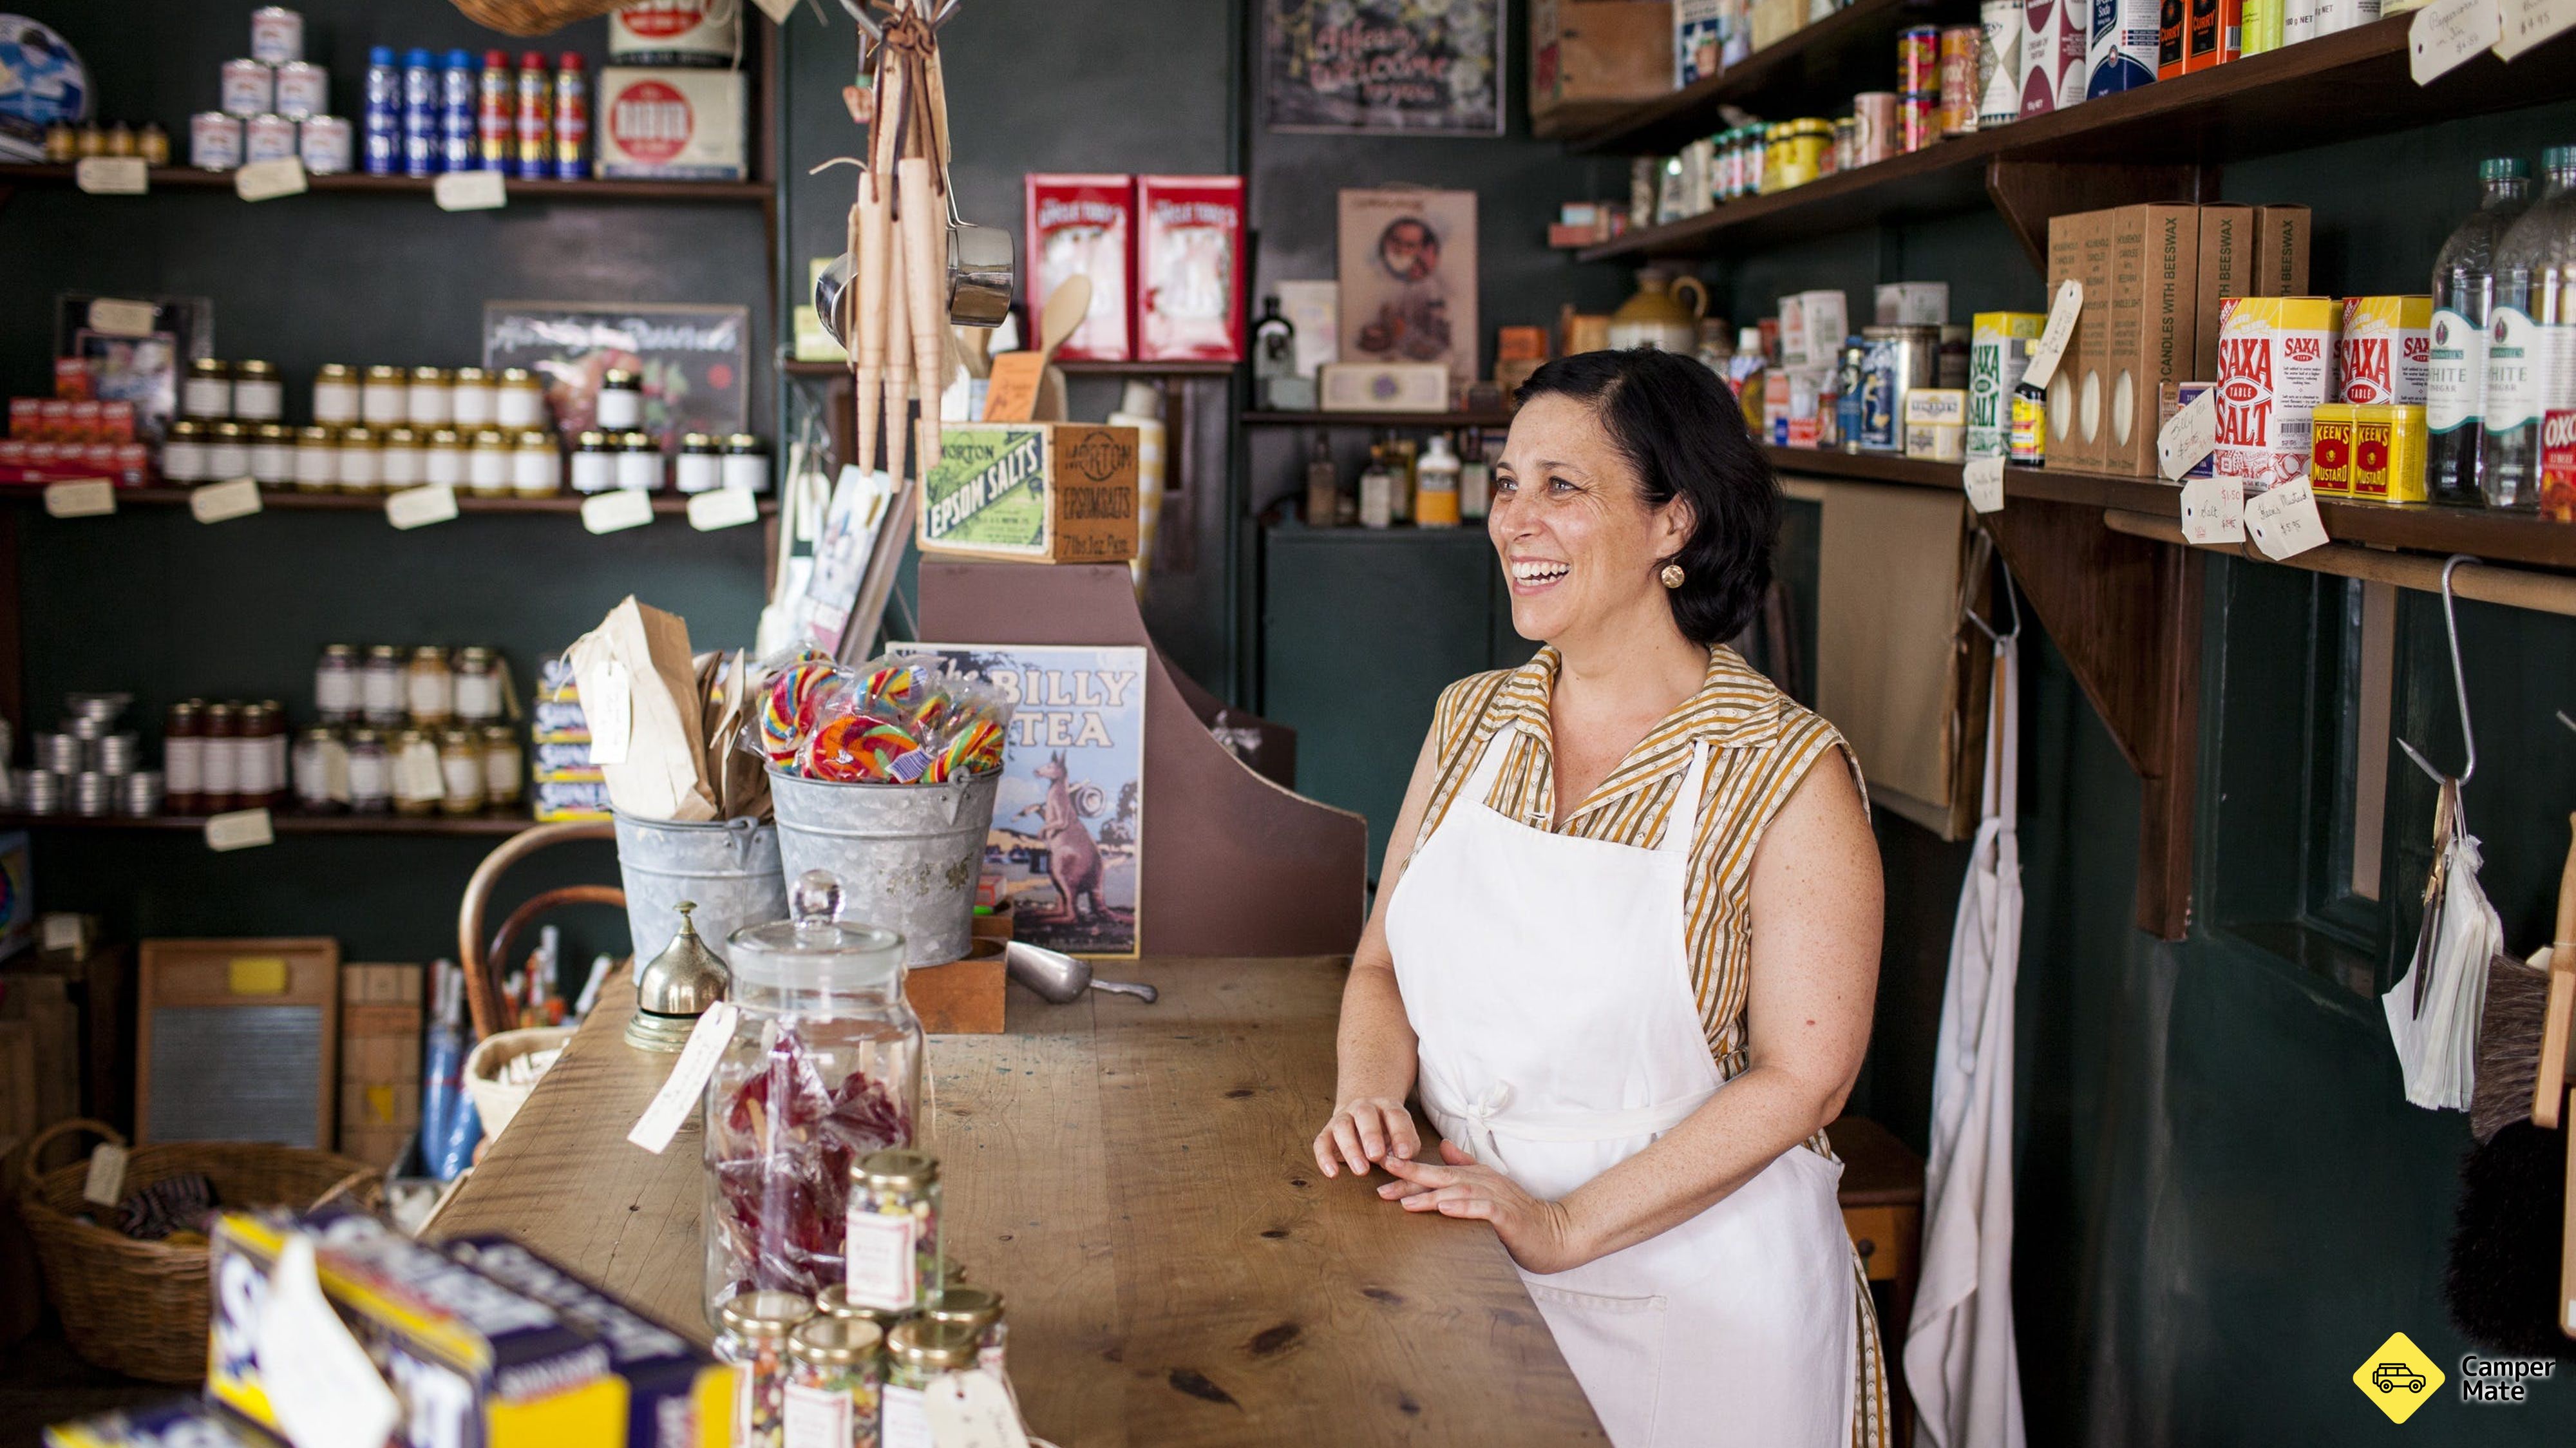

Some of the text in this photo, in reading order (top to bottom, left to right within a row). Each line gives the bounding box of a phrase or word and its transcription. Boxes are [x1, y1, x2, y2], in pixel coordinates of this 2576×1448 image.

[2300, 15, 2313, 24] NET
[2322, 5, 2333, 13] NET
[2193, 10, 2215, 31] CURRY
[2161, 21, 2181, 43] CURRY
[2164, 217, 2177, 280] BEESWAX
[2219, 219, 2233, 280] BEESWAX
[2281, 220, 2293, 281] BEESWAX
[2163, 283, 2175, 314] WITH
[2161, 317, 2175, 374] CANDLES
[2284, 338, 2320, 359] SAXA
[2403, 338, 2430, 357] SAX
[2218, 339, 2273, 392] SAXA
[2340, 339, 2391, 394] SAXA
[2431, 368, 2467, 383] HITE
[2230, 387, 2251, 397] TABLE
[2351, 388, 2371, 399] TABLE
[2215, 395, 2272, 446] SALT
[2545, 414, 2576, 448] OXO
[2316, 426, 2349, 444] KEEN'S
[2358, 427, 2388, 446] KEEN'S
[2315, 463, 2347, 482] MUSTARD
[2356, 466, 2386, 485] MUSTARD
[931, 473, 985, 537] EPSOM
[987, 439, 1038, 500] SALTS
[2222, 489, 2240, 506] $1.50
[991, 670, 1137, 707] BILLY
[1013, 712, 1114, 747] TEA
